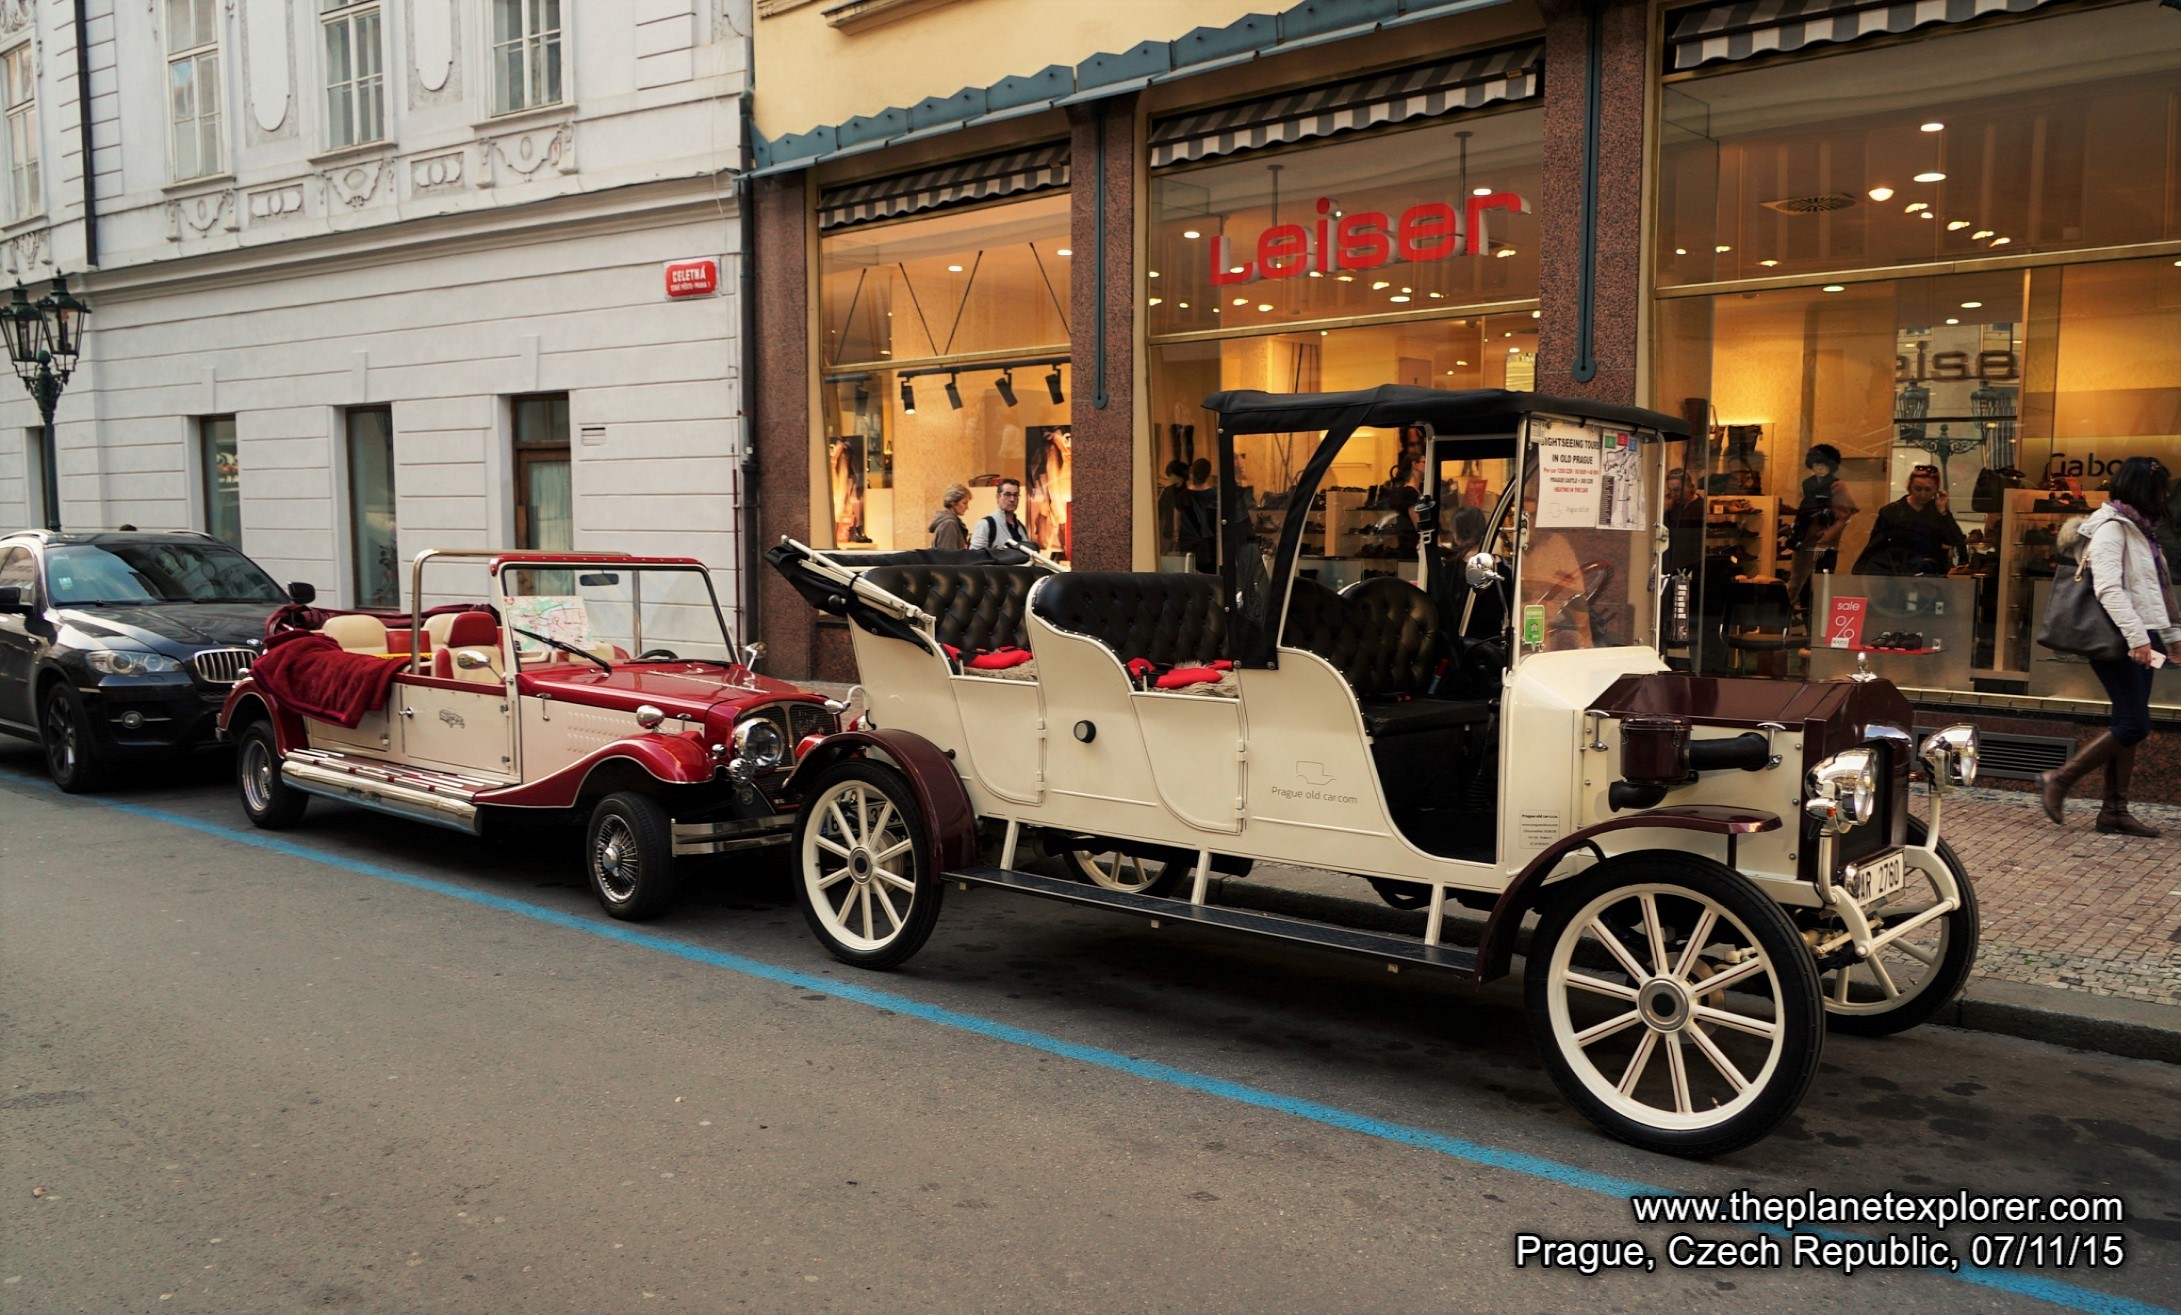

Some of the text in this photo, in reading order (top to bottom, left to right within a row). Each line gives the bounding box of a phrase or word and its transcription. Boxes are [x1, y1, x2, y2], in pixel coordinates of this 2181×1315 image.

[1210, 192, 1530, 286] Leiser
[672, 265, 706, 282] CELETNÁ
[1552, 454, 1593, 465] IN OLD PRAGUE
[2044, 453, 2123, 479] Gabo
[1837, 601, 1861, 611] sale
[1271, 786, 1303, 800] Prague
[1305, 790, 1321, 800] old
